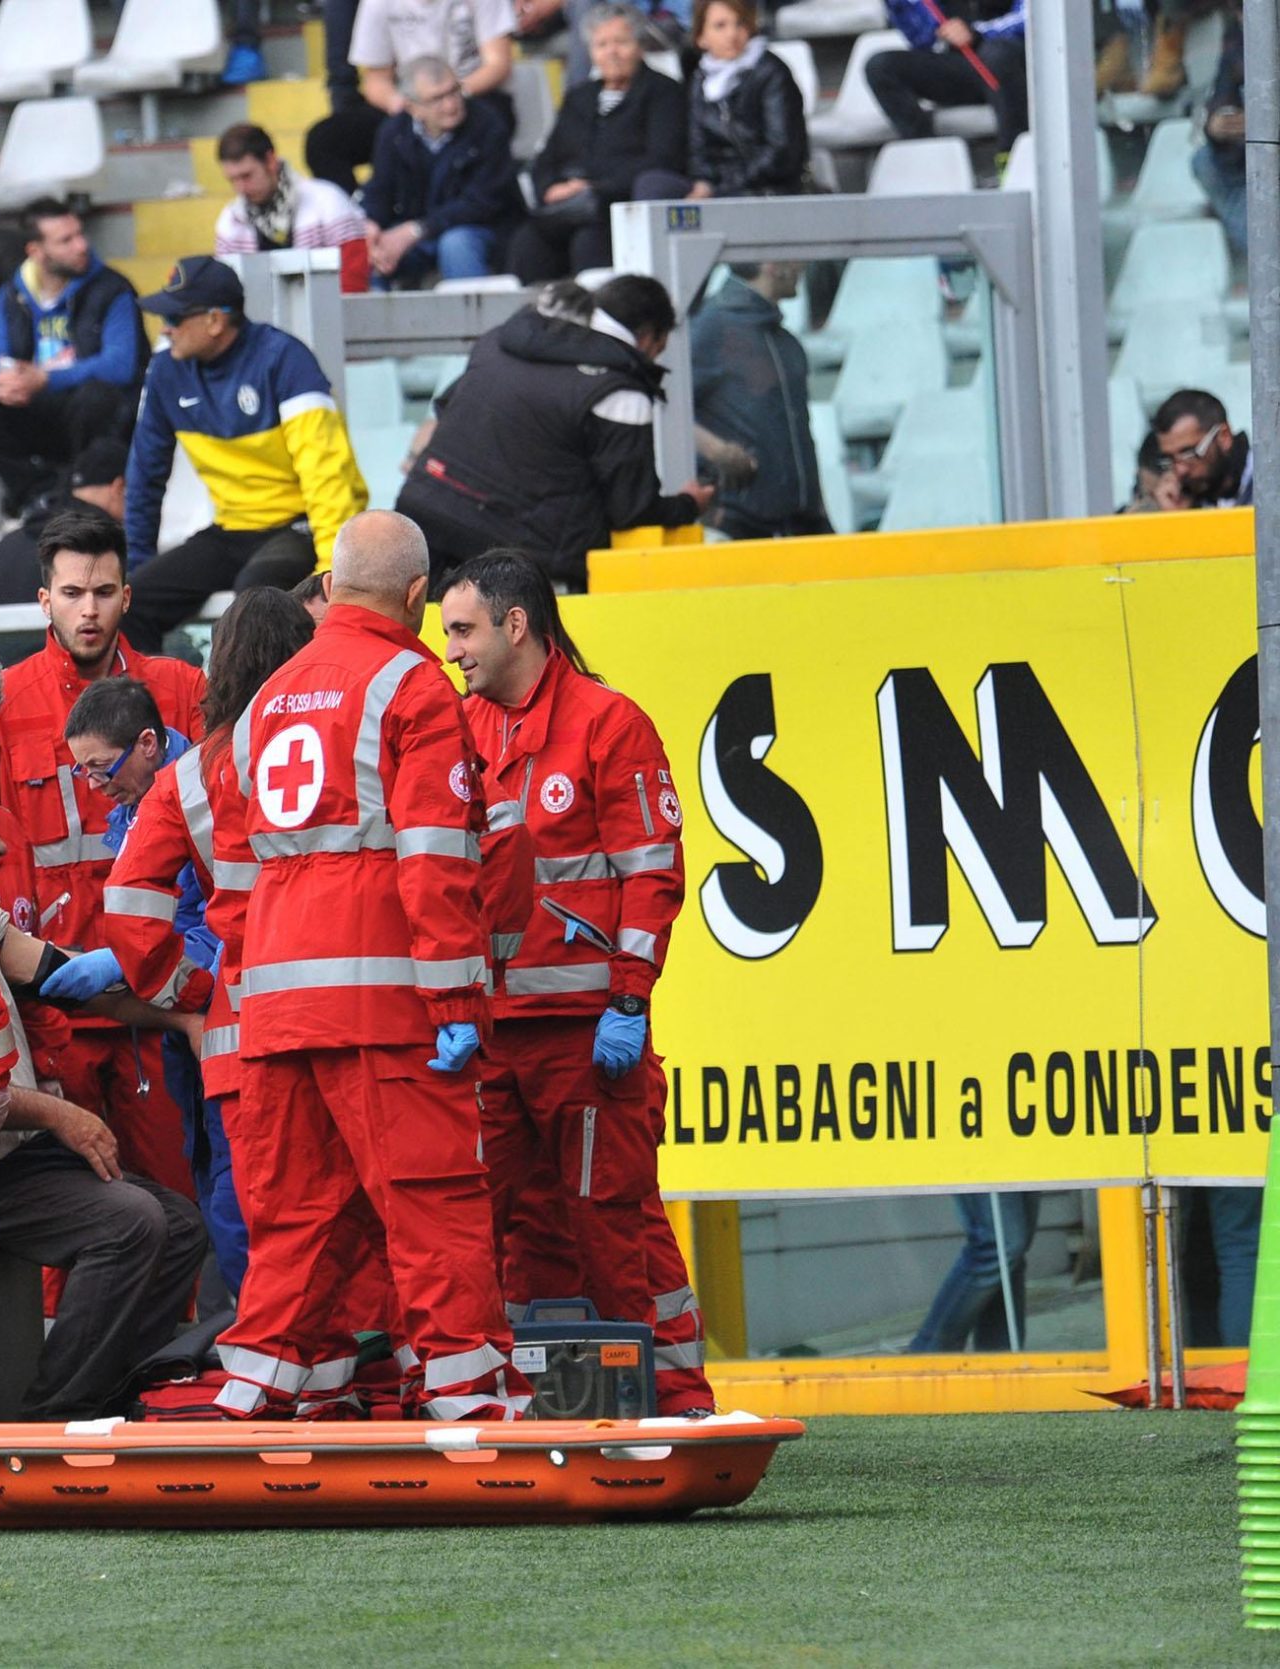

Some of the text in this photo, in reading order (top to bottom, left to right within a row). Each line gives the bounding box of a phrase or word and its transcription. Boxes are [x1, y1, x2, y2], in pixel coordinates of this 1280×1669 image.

[659, 1061, 936, 1146] LDABAGNI
[960, 1077, 982, 1139] a
[605, 1351, 631, 1359] CAMPO
